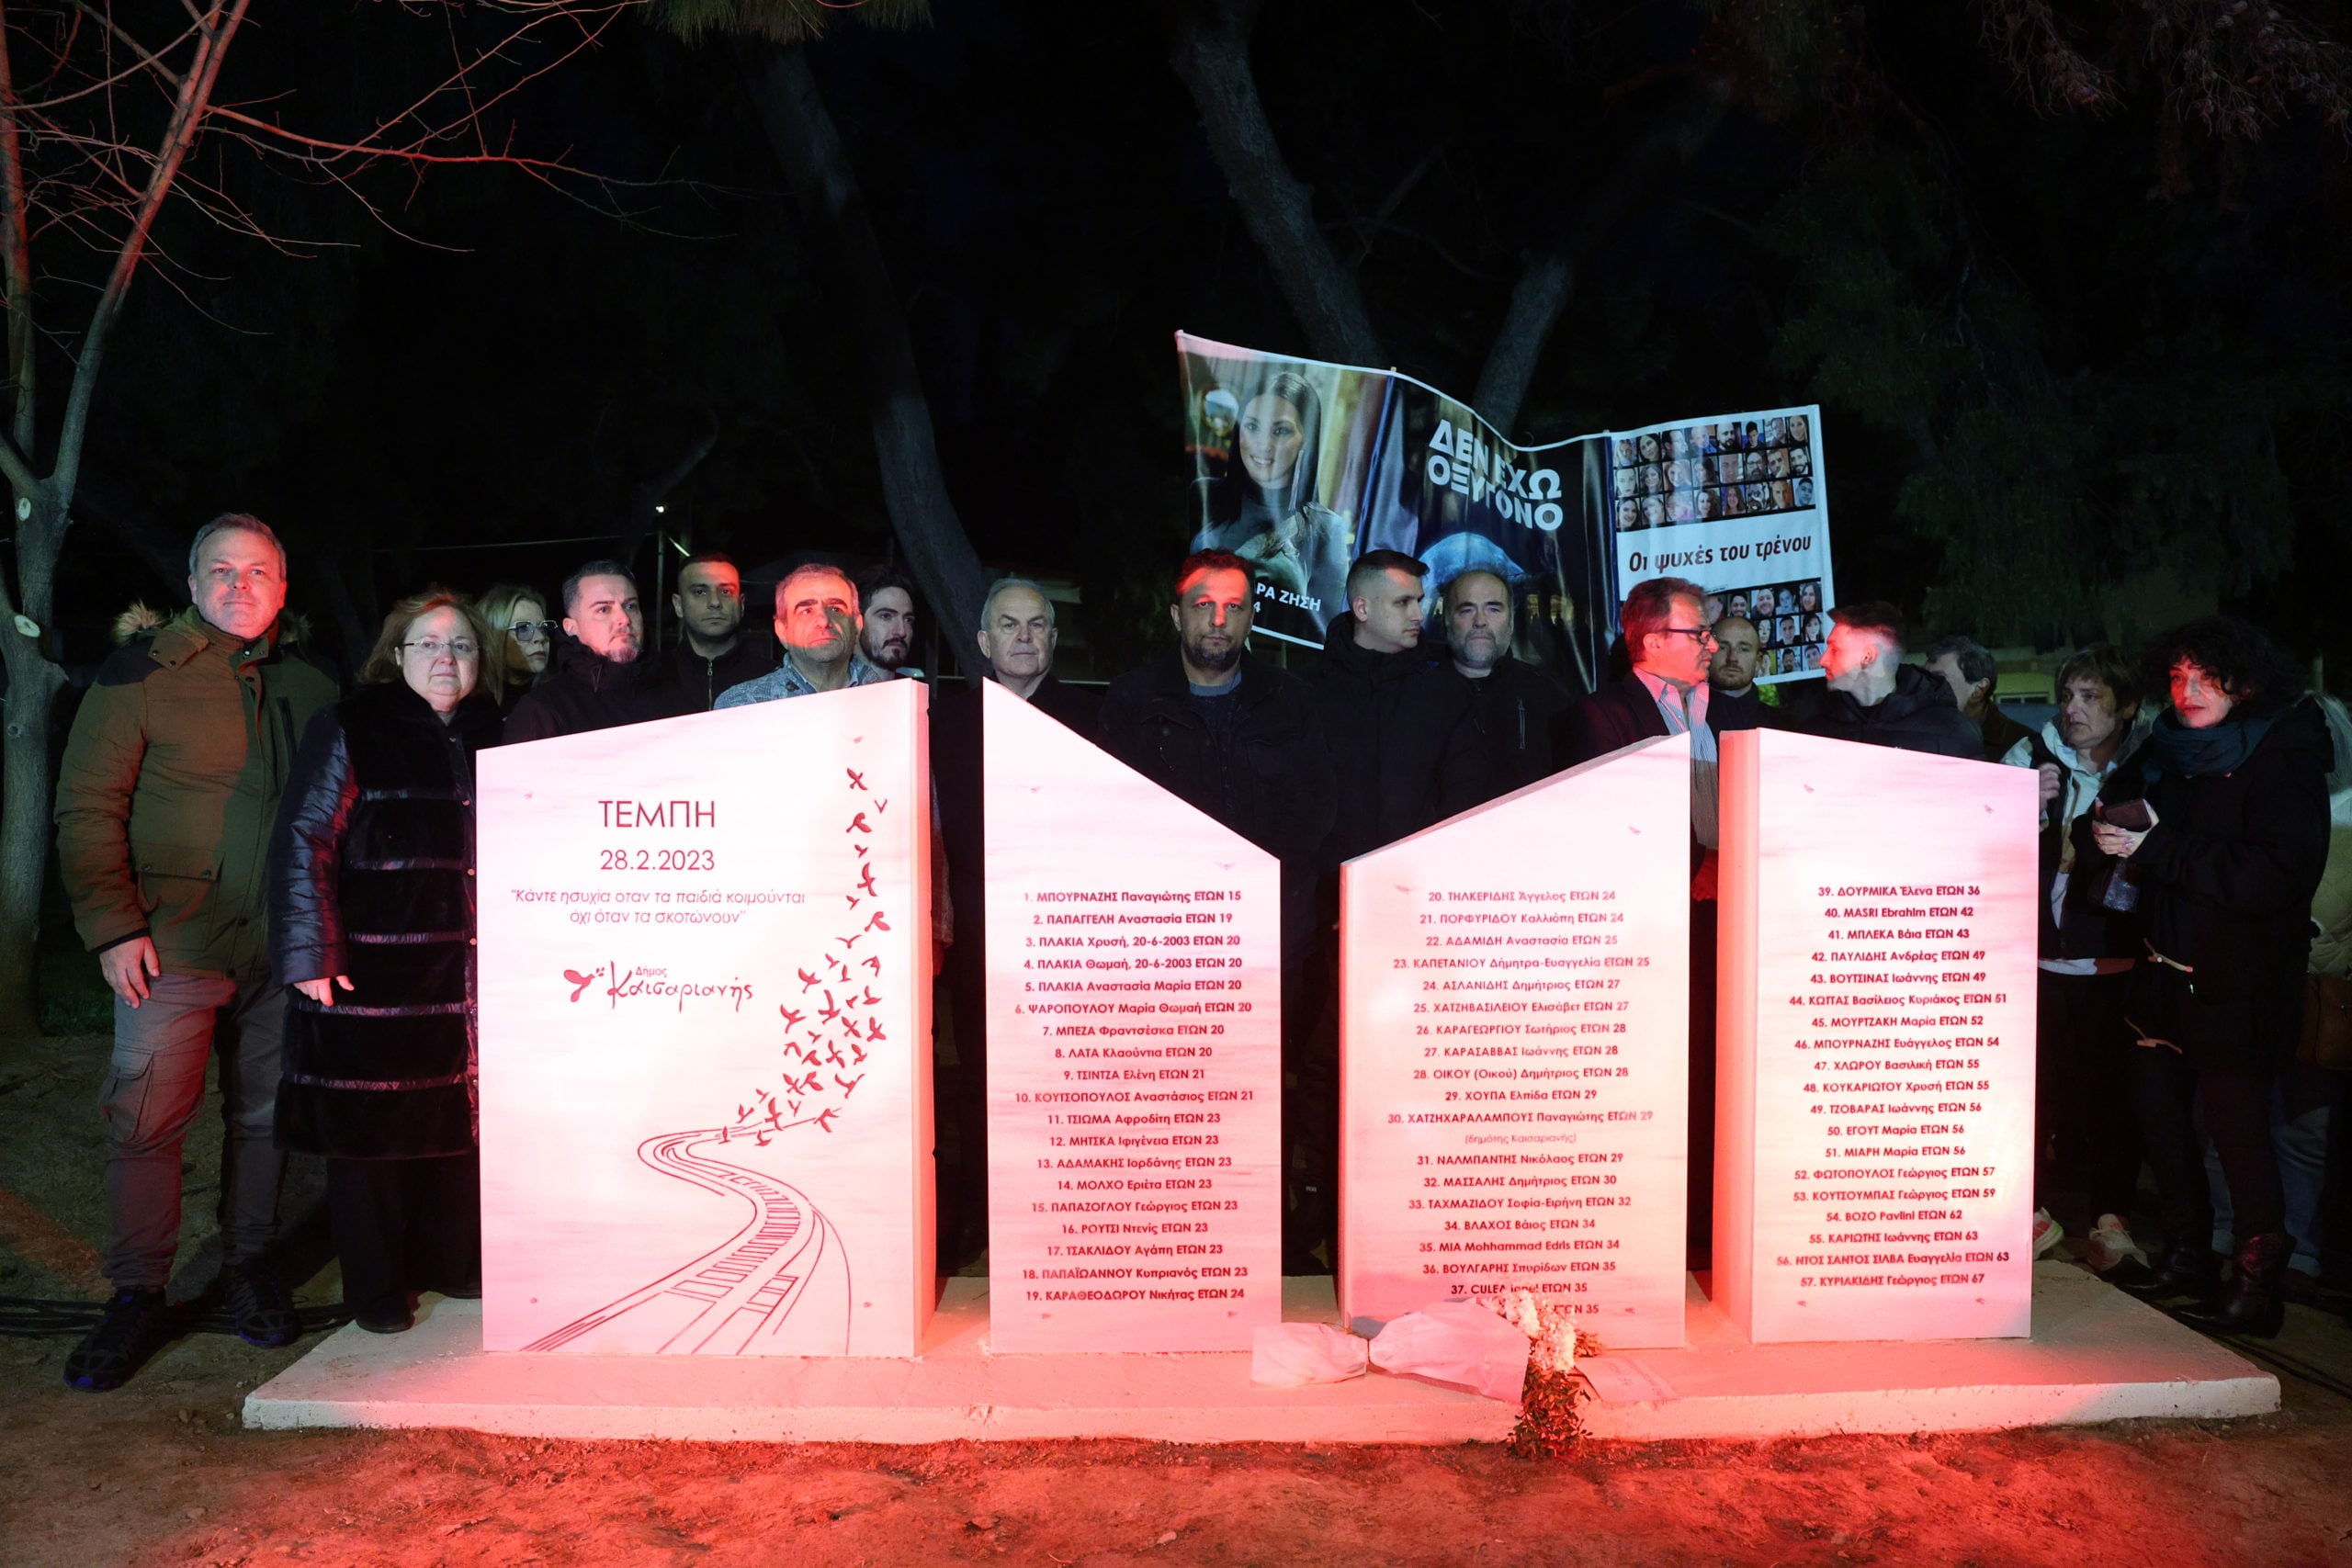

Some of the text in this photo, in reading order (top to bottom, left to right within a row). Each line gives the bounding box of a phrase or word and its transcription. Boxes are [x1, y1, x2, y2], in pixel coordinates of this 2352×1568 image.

[1429, 419, 1562, 500] ΔΕΝ ΕΧΩ
[1428, 455, 1563, 531] ΟΞΥΓΟΝΟ
[1629, 535, 1812, 573] Οι ψυχές του τρένου
[1279, 590, 1321, 611] ΖΗΣΗ
[598, 801, 716, 828] ΤΕΜΠΗ
[600, 850, 715, 871] 28.2.2023
[560, 889, 610, 905] ησυχία
[655, 892, 671, 903] τα
[676, 889, 721, 903] παιδιά
[727, 889, 805, 905] κοιμούνται
[570, 908, 590, 924] όχι
[594, 908, 629, 923] όταν
[635, 911, 650, 923] τα
[1034, 913, 1232, 924] 2. ΠΑΠΑΓΓΕΛΗ Αναστασία ΕΤΩΝ 19
[1420, 913, 1623, 925] 21. ΠΟΡΦΥΡΙΔΟΥ Καλλιόπη ΕΤΩΝ 24
[1426, 935, 1617, 946] 22. ΑΔΑΜΙΔΗ Αναστασία ΕΤΩΝ 25
[1828, 929, 1970, 939] 41. ΜΠΛΕΚΑ Βάια ΕΤΩΝ 43
[1812, 950, 1985, 963] 42. ΠΑΥΛΙΔΗΣ Ανδρέας ΕΤΩΝ 49
[635, 965, 668, 978] Δήμος
[1810, 972, 1986, 985] 43. ΒΟΥΤΣΙΝΑΣ Ιωάννης ΕΤΩΝ 49
[606, 960, 753, 1013] Καισαριανής
[1025, 979, 1241, 993] 5. ΠΛΑΚΙΑ Αναστασία Μαρία ΕΤΩΝ 20
[1812, 1016, 1984, 1028] 45. ΜΟΥΡΤΖΑΚΗ Μαρία ΕΤΩΝ 52
[1043, 1024, 1225, 1037] 7. ΜΠΕΖΑ Φραντσέσκα ΕΤΩΝ 20
[1794, 1037, 1999, 1049] 46. ΜΠΟΥΡΝΑΖΗΣ Ευάγγελος ΕΤΩΝ 54
[1055, 1047, 1212, 1058] 8. ΛΑΤΑ Κλαούντια ΕΤΩΝ 20
[1064, 1069, 1204, 1081] 9. ΤΣΙΝΤΖΑ Ελένη ΕΤΩΝ 21
[1810, 1102, 1982, 1115] 49. ΤΖΟΒΑΡΑΣ Ιωάννης ΕΤΩΝ 56
[1048, 1113, 1220, 1126] 11. ΤΣΙΩΜΑ Αφροδίτη ΕΤΩΝ 23
[1038, 1156, 1231, 1169] 13. ΑΔΑΜΑΚΗΣ Ιορδάνης ΕΤΩΝ 23
[1417, 1153, 1623, 1166] 31. ΝΑΛΜΠΑΝΤΗΣ Νικόλαος ΕΤΩΝ 29
[1058, 1179, 1212, 1191] 14. ΜΟΛΧΟ Εριέτα ΕΤΩΝ 23
[1424, 1175, 1617, 1188] 32. ΜΑΣΣΑΛΗΣ Δημήτριος ΕΤΩΝ 30
[1409, 1197, 1631, 1210] 33. ΤΑΧΜΑΖΙΔΟΥ Σοφία-Ειρήνη ΕΤΩΝ 32
[1444, 1219, 1595, 1232] 34. ΒΛΑΧΟΣ Βάιος ΕΤΩΝ 34
[1809, 1231, 1978, 1244] 55. ΚΑΡΙΩΤΗΣ Ιωάννης ΕΤΩΝ 63
[1047, 1244, 1223, 1257] 17. ΤΣΑΚΛΙΔΟΥ Αγάπη ΕΤΩΝ 23
[1423, 1261, 1616, 1274] 36. ΒΟΥΛΓΑΡΗΣ Σπυρίδων ΕΤΩΝ 35
[1026, 1289, 1244, 1302] 19. ΚΑΡΑΘΕΟΔΩΡΟΥ Νικήτας ΕΤΩΝ 24
